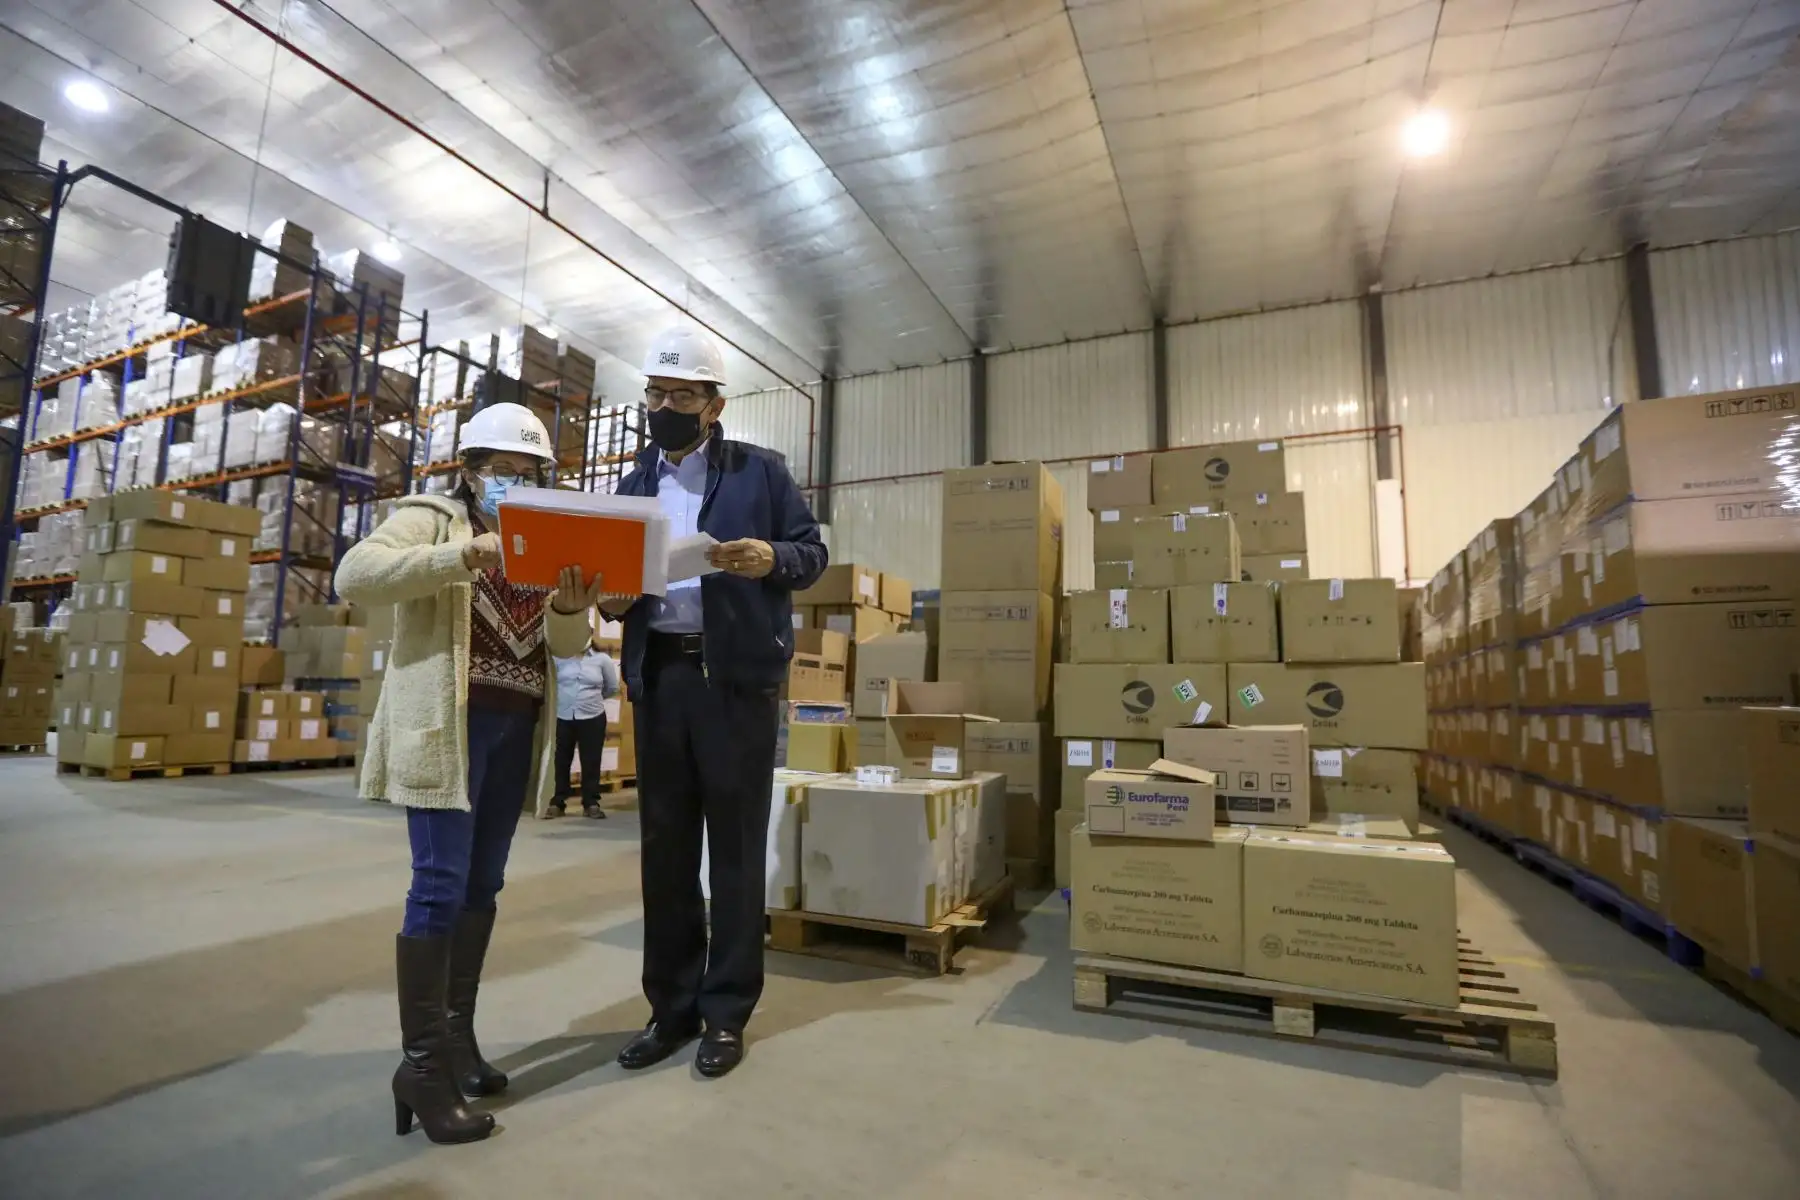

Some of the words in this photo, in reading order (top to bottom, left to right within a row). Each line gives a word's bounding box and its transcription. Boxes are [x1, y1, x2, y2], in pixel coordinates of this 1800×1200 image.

[659, 352, 680, 366] CENARES
[1178, 683, 1192, 699] SPX
[1244, 687, 1258, 704] SPX
[1127, 792, 1190, 805] Eurofarma
[1272, 905, 1344, 922] Carbamazepina
[1345, 914, 1363, 924] 200
[1364, 918, 1380, 928] mg
[1286, 946, 1344, 963] Laboratorios
[1345, 955, 1404, 973] Americanos
